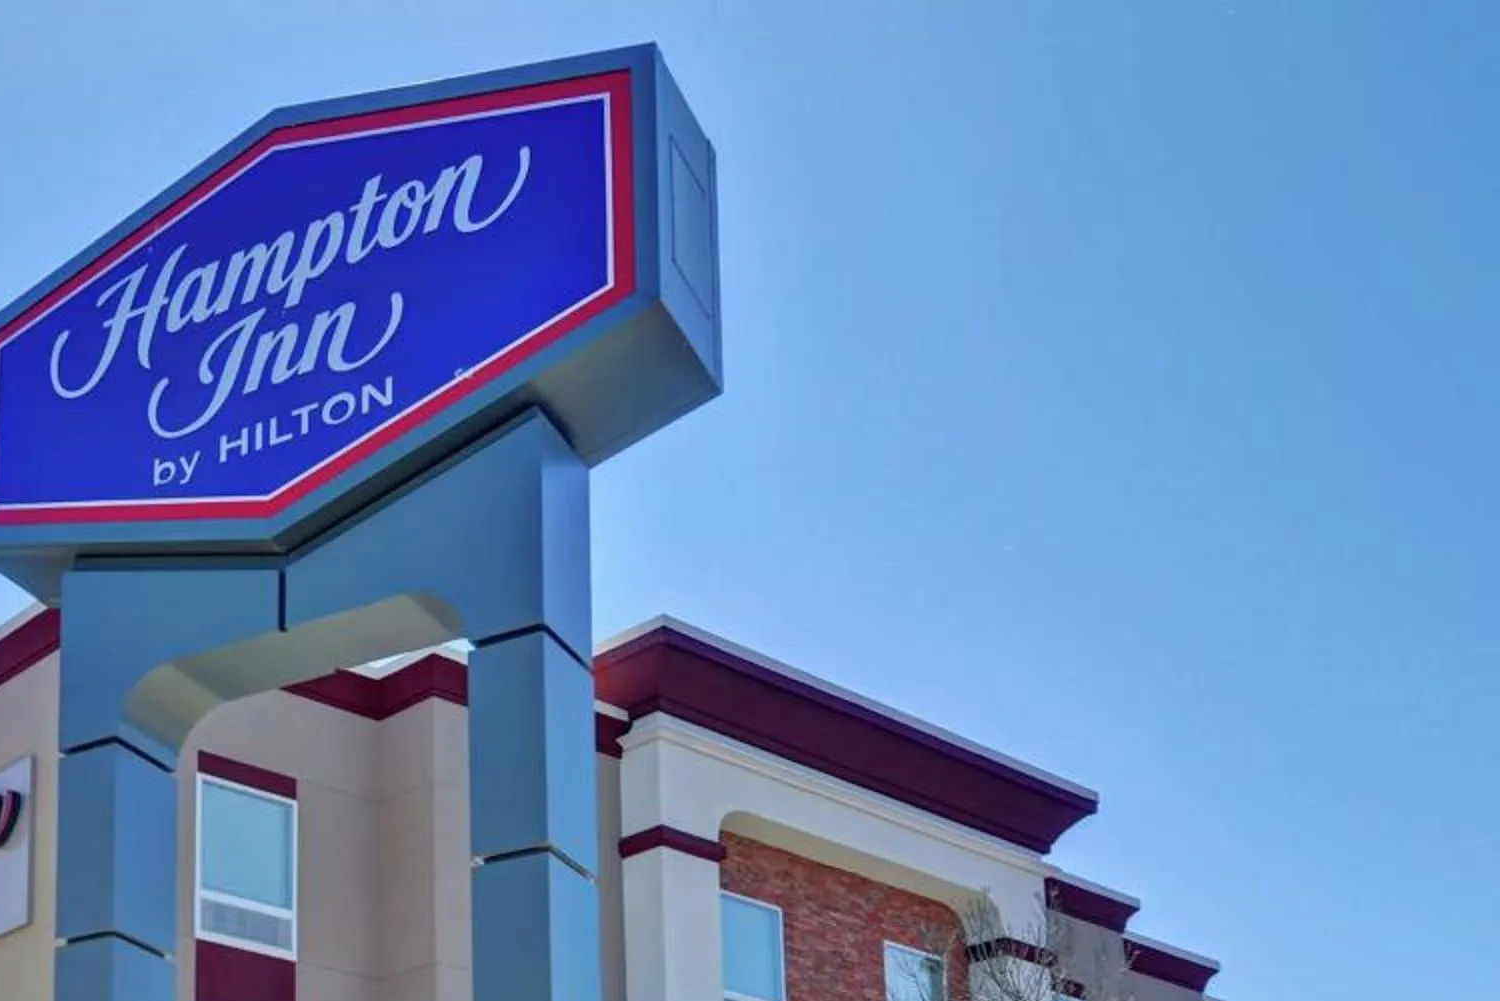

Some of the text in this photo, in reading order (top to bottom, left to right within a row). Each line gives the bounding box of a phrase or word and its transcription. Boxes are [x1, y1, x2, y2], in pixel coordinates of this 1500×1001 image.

[51, 146, 531, 398] Hampton
[148, 292, 403, 438] Inn
[153, 376, 394, 486] by HILTON
